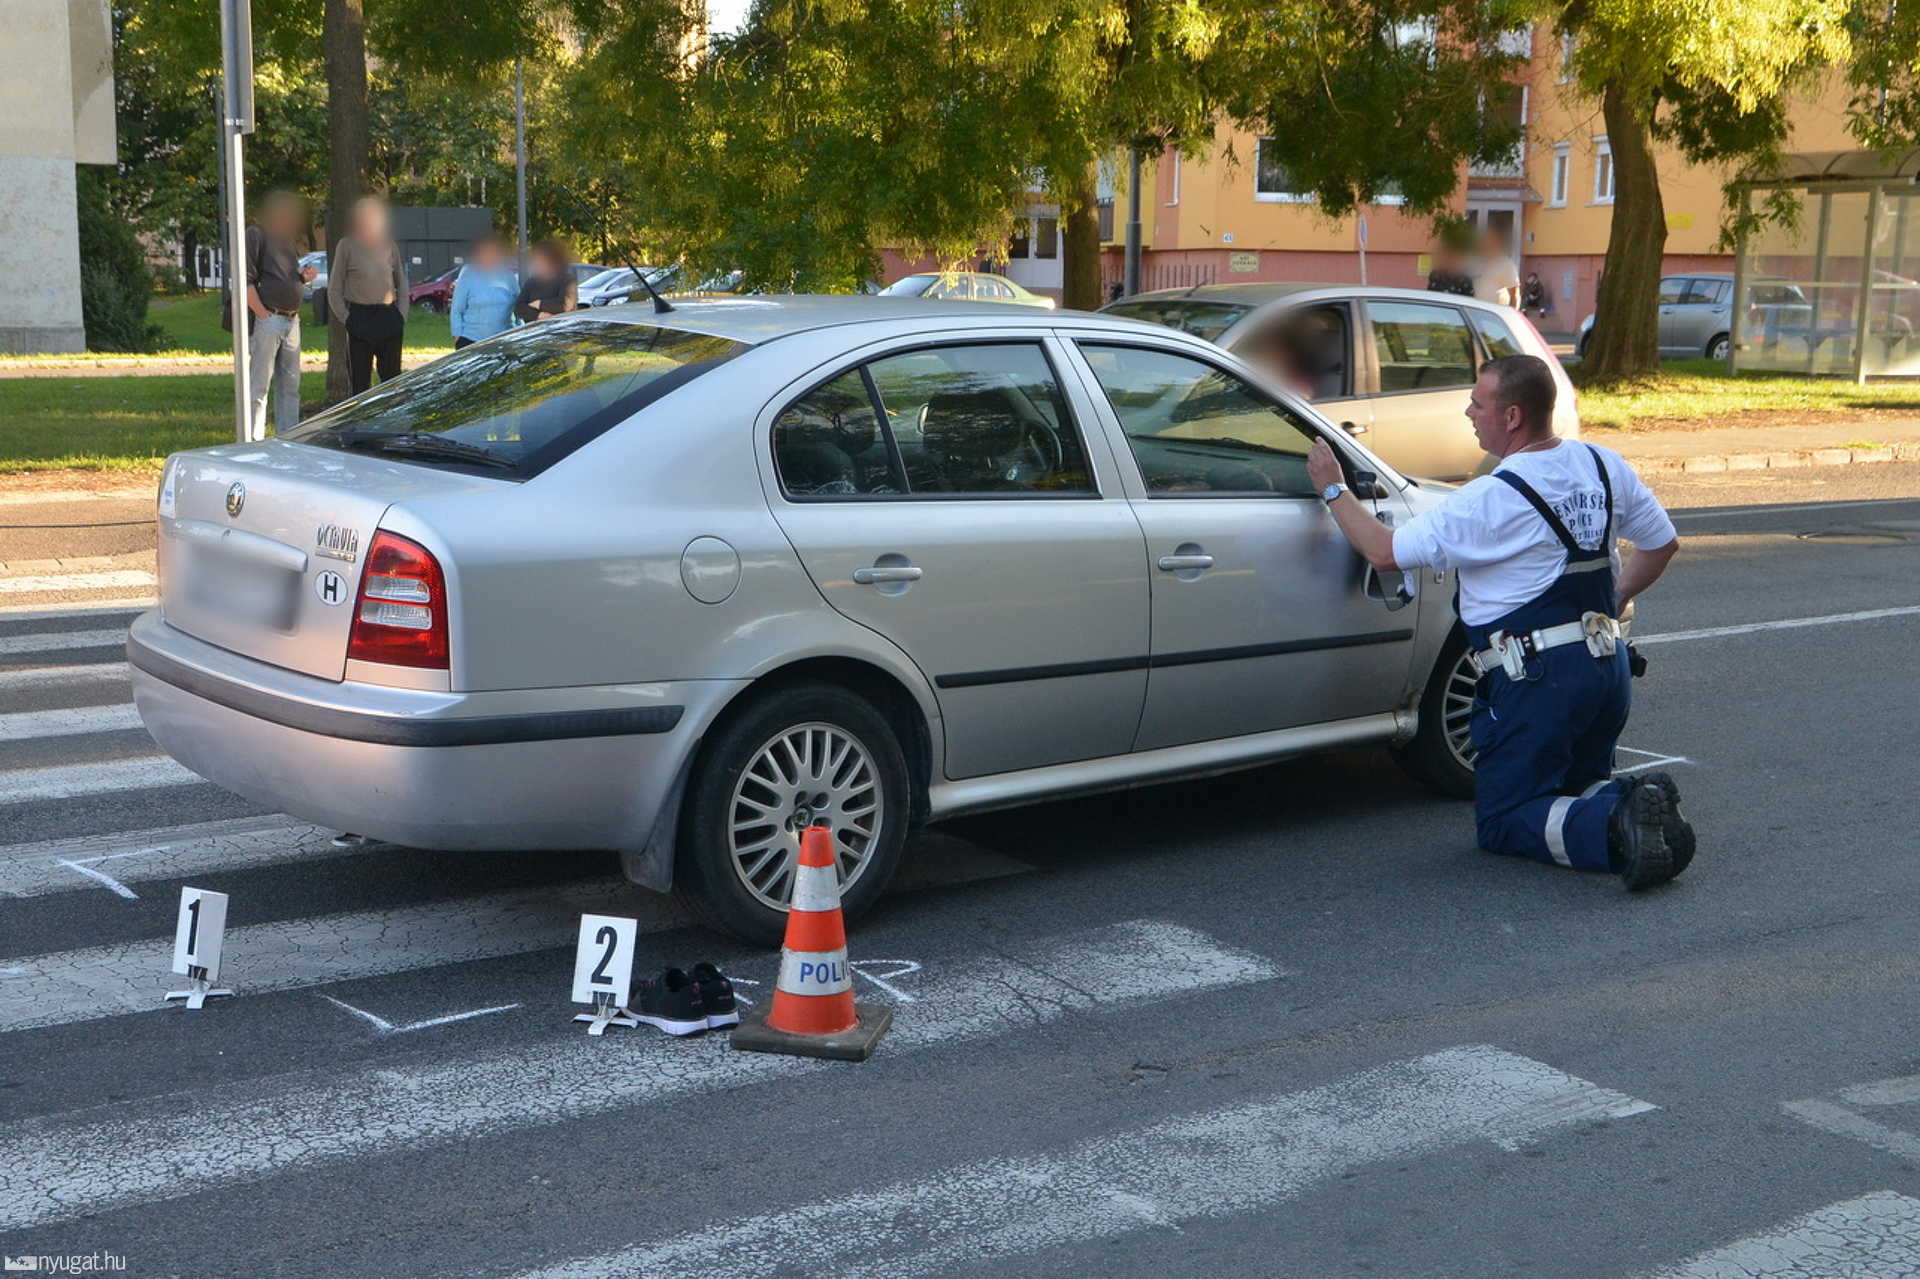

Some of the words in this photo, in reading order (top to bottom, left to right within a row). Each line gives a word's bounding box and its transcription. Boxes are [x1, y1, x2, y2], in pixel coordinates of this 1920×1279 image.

[324, 573, 337, 602] H
[187, 899, 201, 955] 1
[591, 926, 618, 985] 2
[799, 961, 849, 984] POLI
